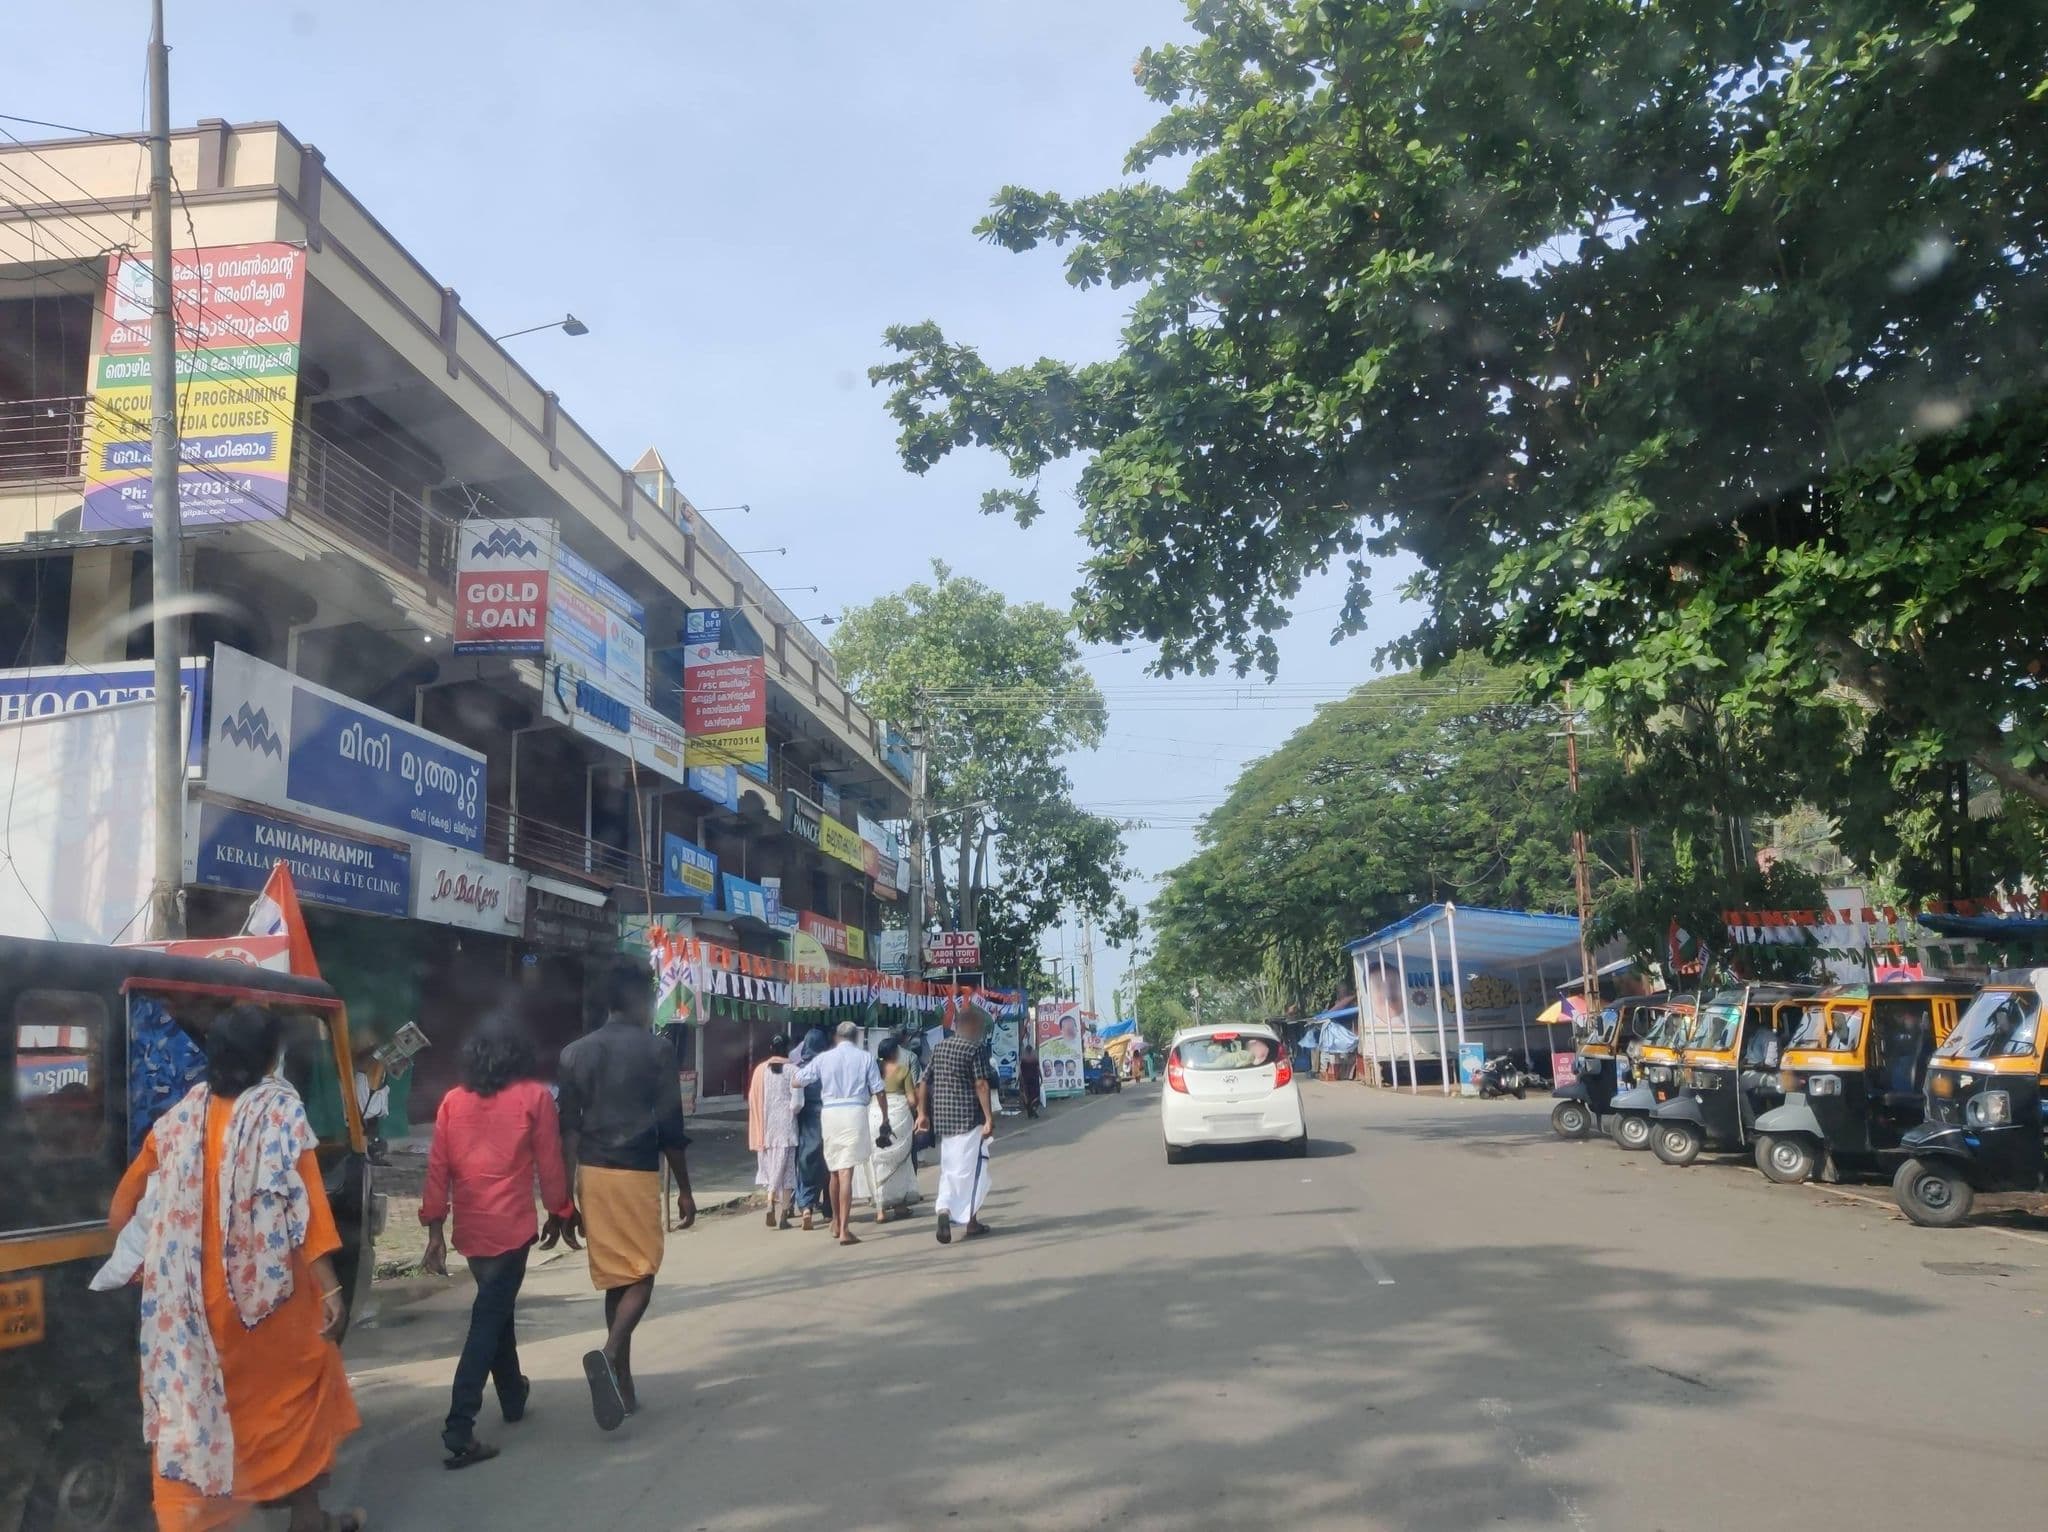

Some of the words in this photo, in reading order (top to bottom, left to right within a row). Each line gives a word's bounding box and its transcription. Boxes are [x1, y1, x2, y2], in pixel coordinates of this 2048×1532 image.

[194, 386, 287, 406] PROGRAMMING
[211, 410, 269, 428] COURSES
[467, 582, 539, 603] GOLD
[466, 608, 537, 628] LOAN
[339, 722, 391, 772] മിനി
[255, 824, 375, 869] KANIAMPARAMPIL
[216, 844, 270, 870] KERALA
[332, 869, 341, 884] &
[344, 871, 365, 890] EYE
[366, 876, 401, 896] CLINIC
[431, 869, 452, 901] Jo
[453, 874, 500, 912] Bakers
[945, 933, 976, 947] DDC
